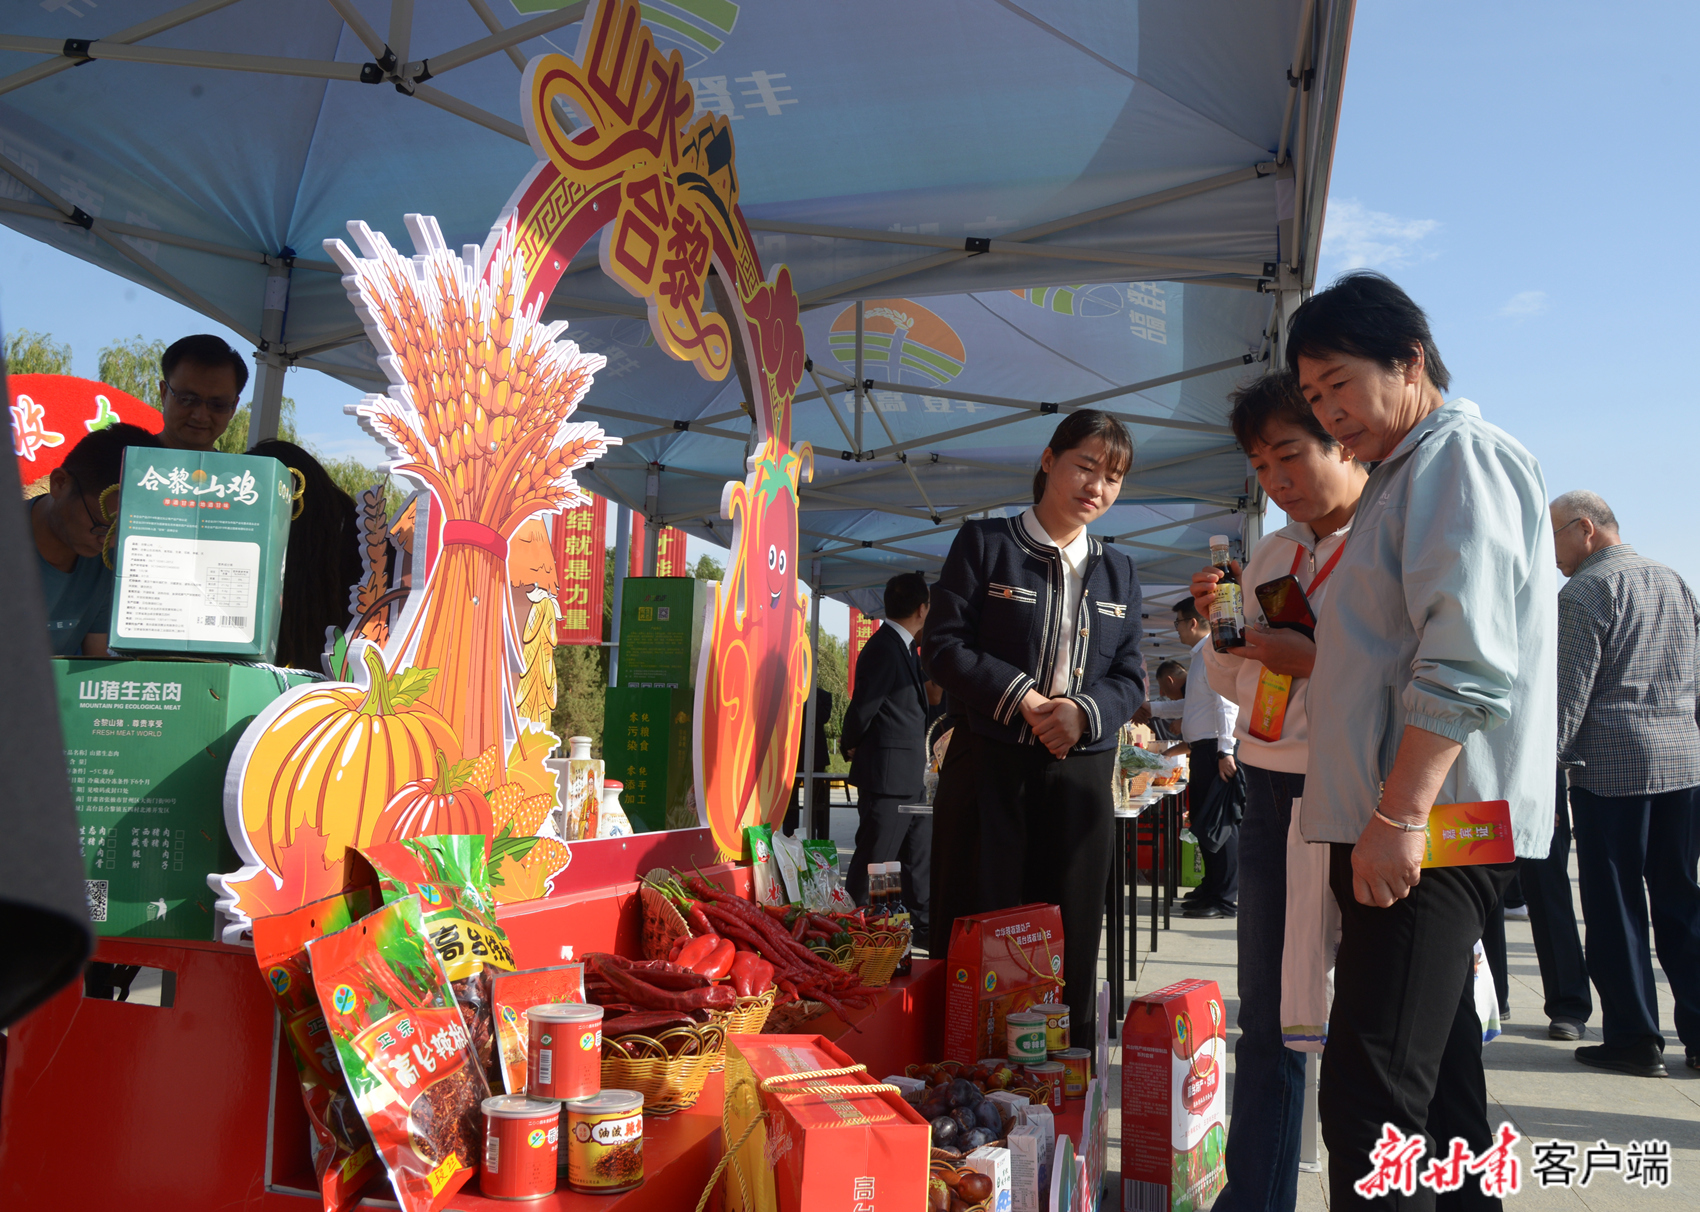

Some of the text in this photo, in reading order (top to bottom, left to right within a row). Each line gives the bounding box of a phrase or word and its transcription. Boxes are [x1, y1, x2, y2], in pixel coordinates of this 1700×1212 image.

[137, 466, 259, 505] 合黎山鸡
[79, 680, 182, 701] 山猪生态肉
[376, 1019, 415, 1050] 正宗
